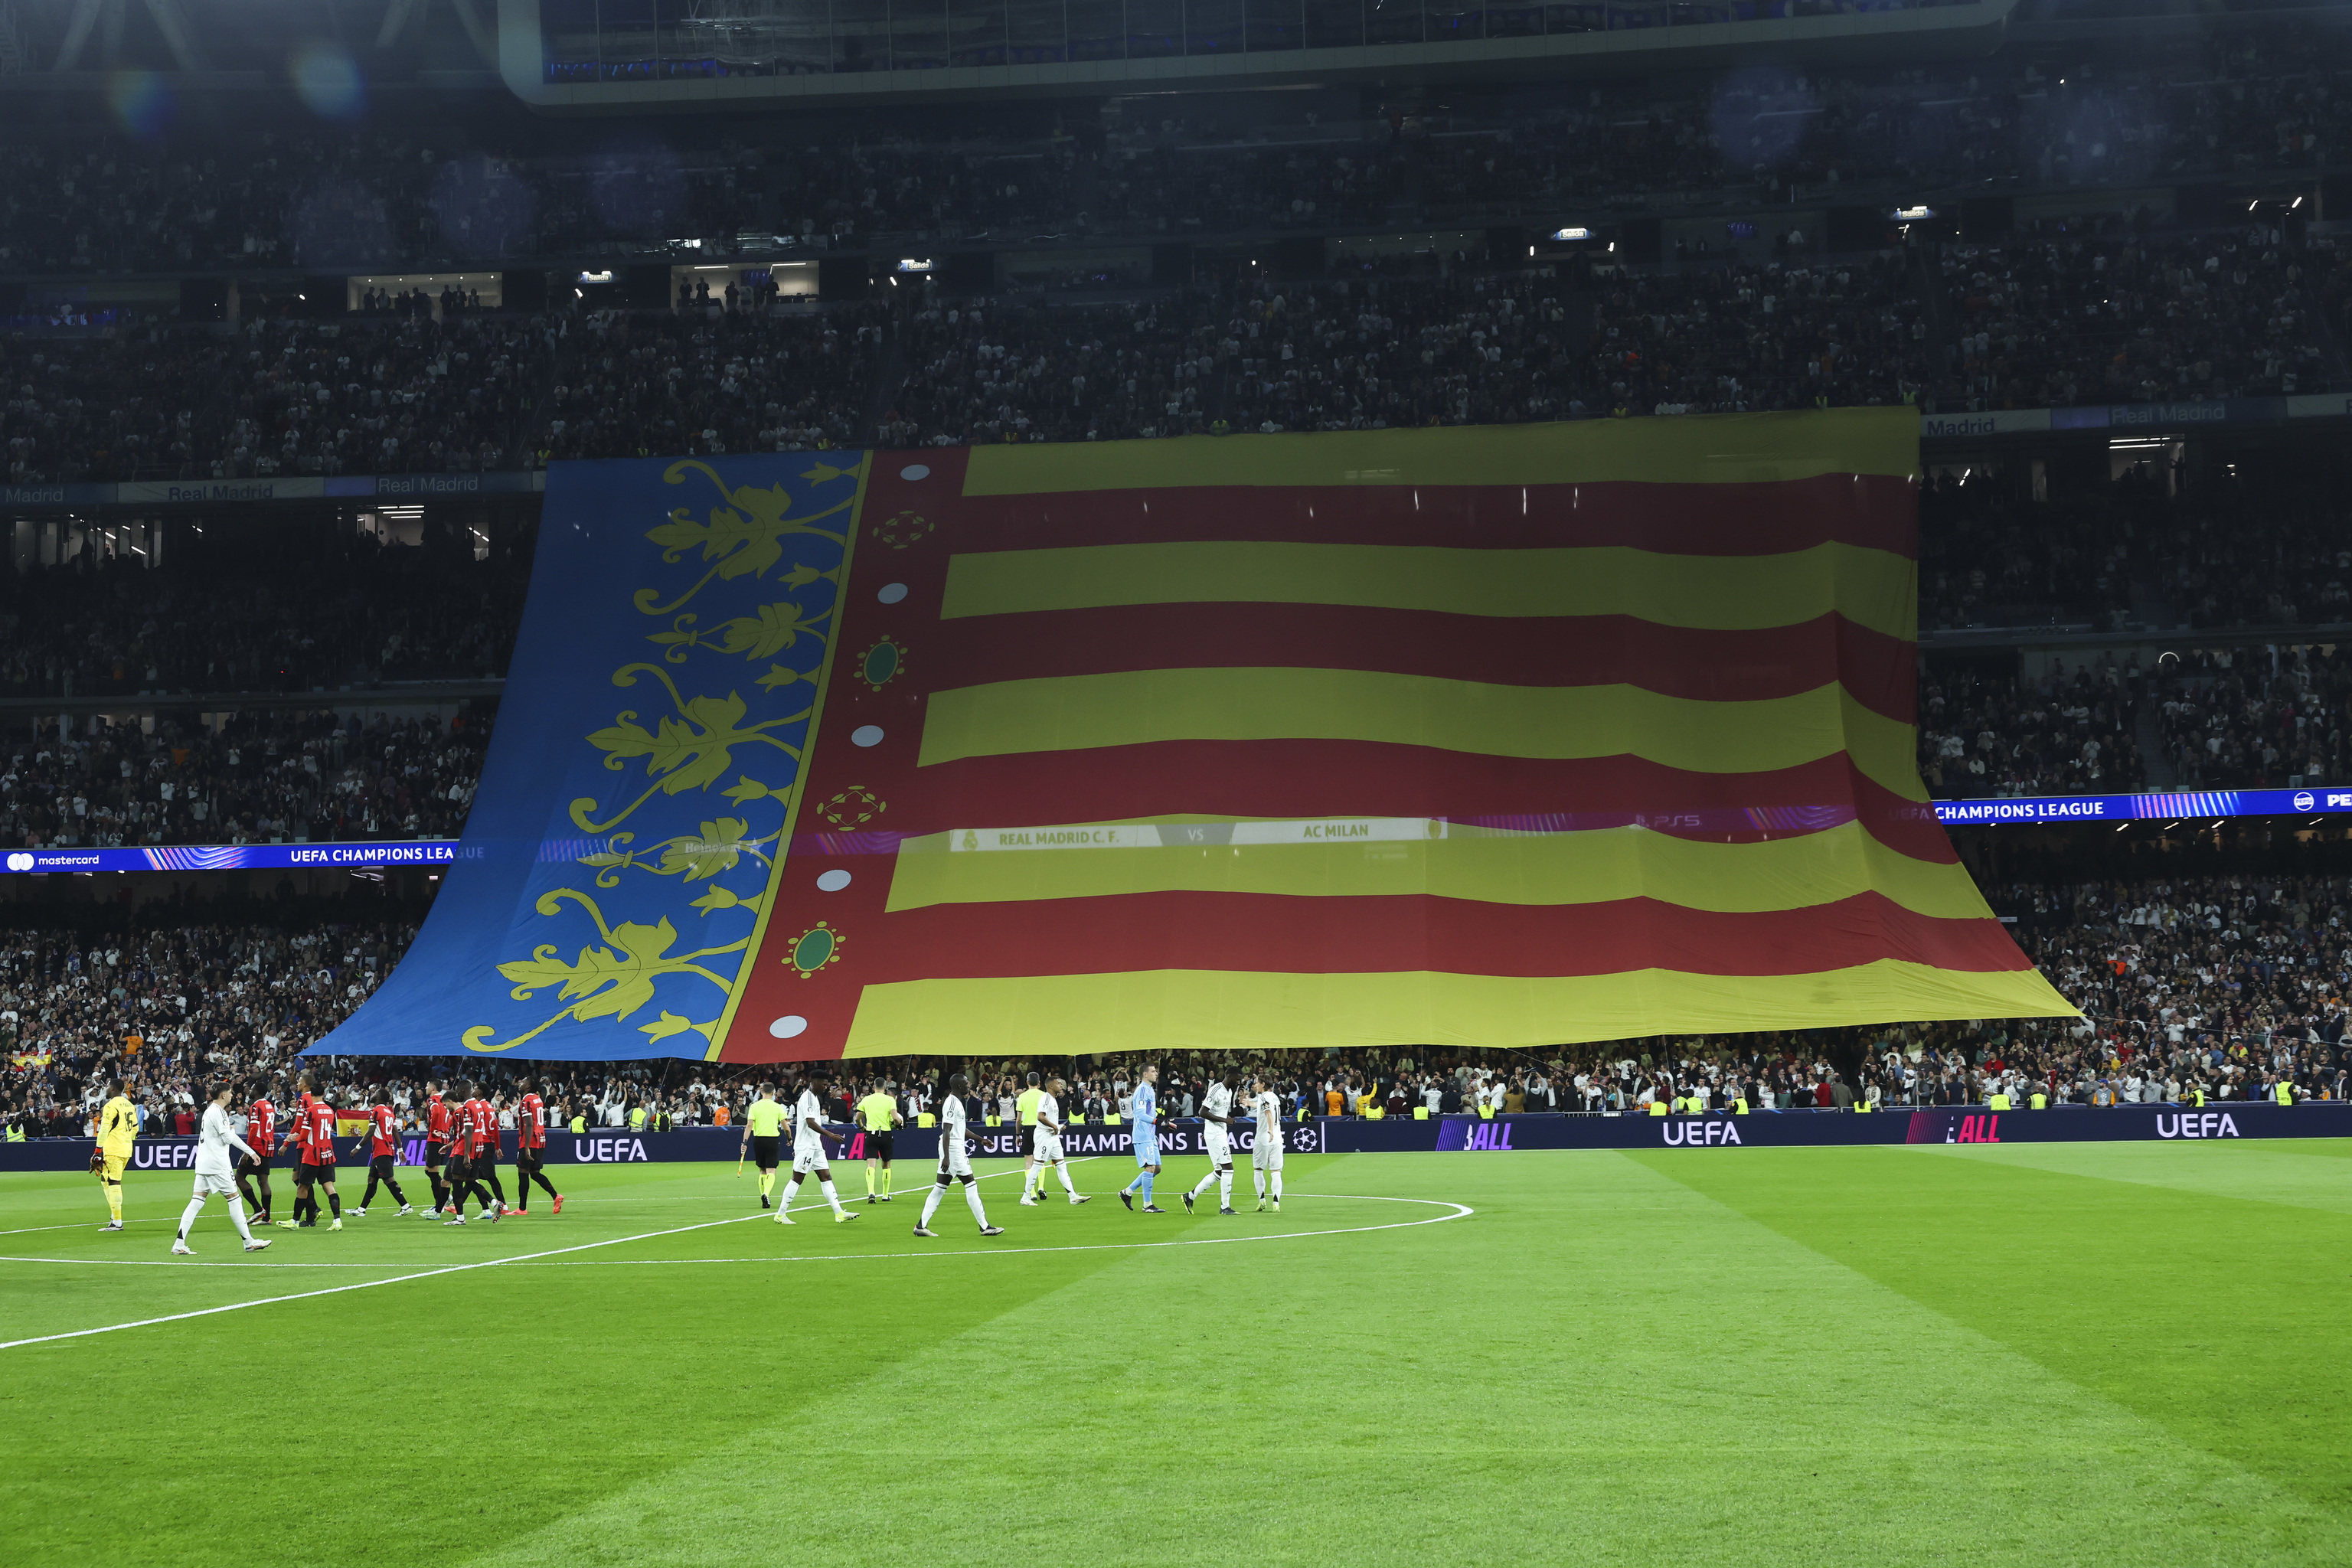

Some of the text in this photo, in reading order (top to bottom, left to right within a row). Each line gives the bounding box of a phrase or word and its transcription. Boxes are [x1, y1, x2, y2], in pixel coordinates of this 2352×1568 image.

[2112, 404, 2226, 424] Real Madrid
[1927, 418, 1995, 436] Madrid
[168, 485, 273, 500] Real Madrid
[378, 476, 478, 493] Real Madrid
[5, 488, 64, 503] Madrid
[1934, 805, 2034, 820] CHAMPIONS
[2039, 802, 2104, 816] LEAGUE
[999, 832, 1032, 846] REAL
[1036, 831, 1089, 844] MADRID
[1187, 828, 1204, 841] VS
[1303, 824, 1369, 838] AC MILAN
[38, 855, 100, 865] mastercard
[291, 850, 328, 862] UEFA
[332, 847, 423, 861] CHAMPIONS
[124, 1111, 133, 1132] 16
[319, 1118, 332, 1140] 14
[2156, 1112, 2239, 1138] UEFA
[1663, 1121, 1742, 1145] UEFA
[576, 1138, 648, 1162] UEFA
[1041, 1145, 1047, 1155] 9
[1058, 1132, 1187, 1152] HAMPNS
[802, 1156, 812, 1166] 14
